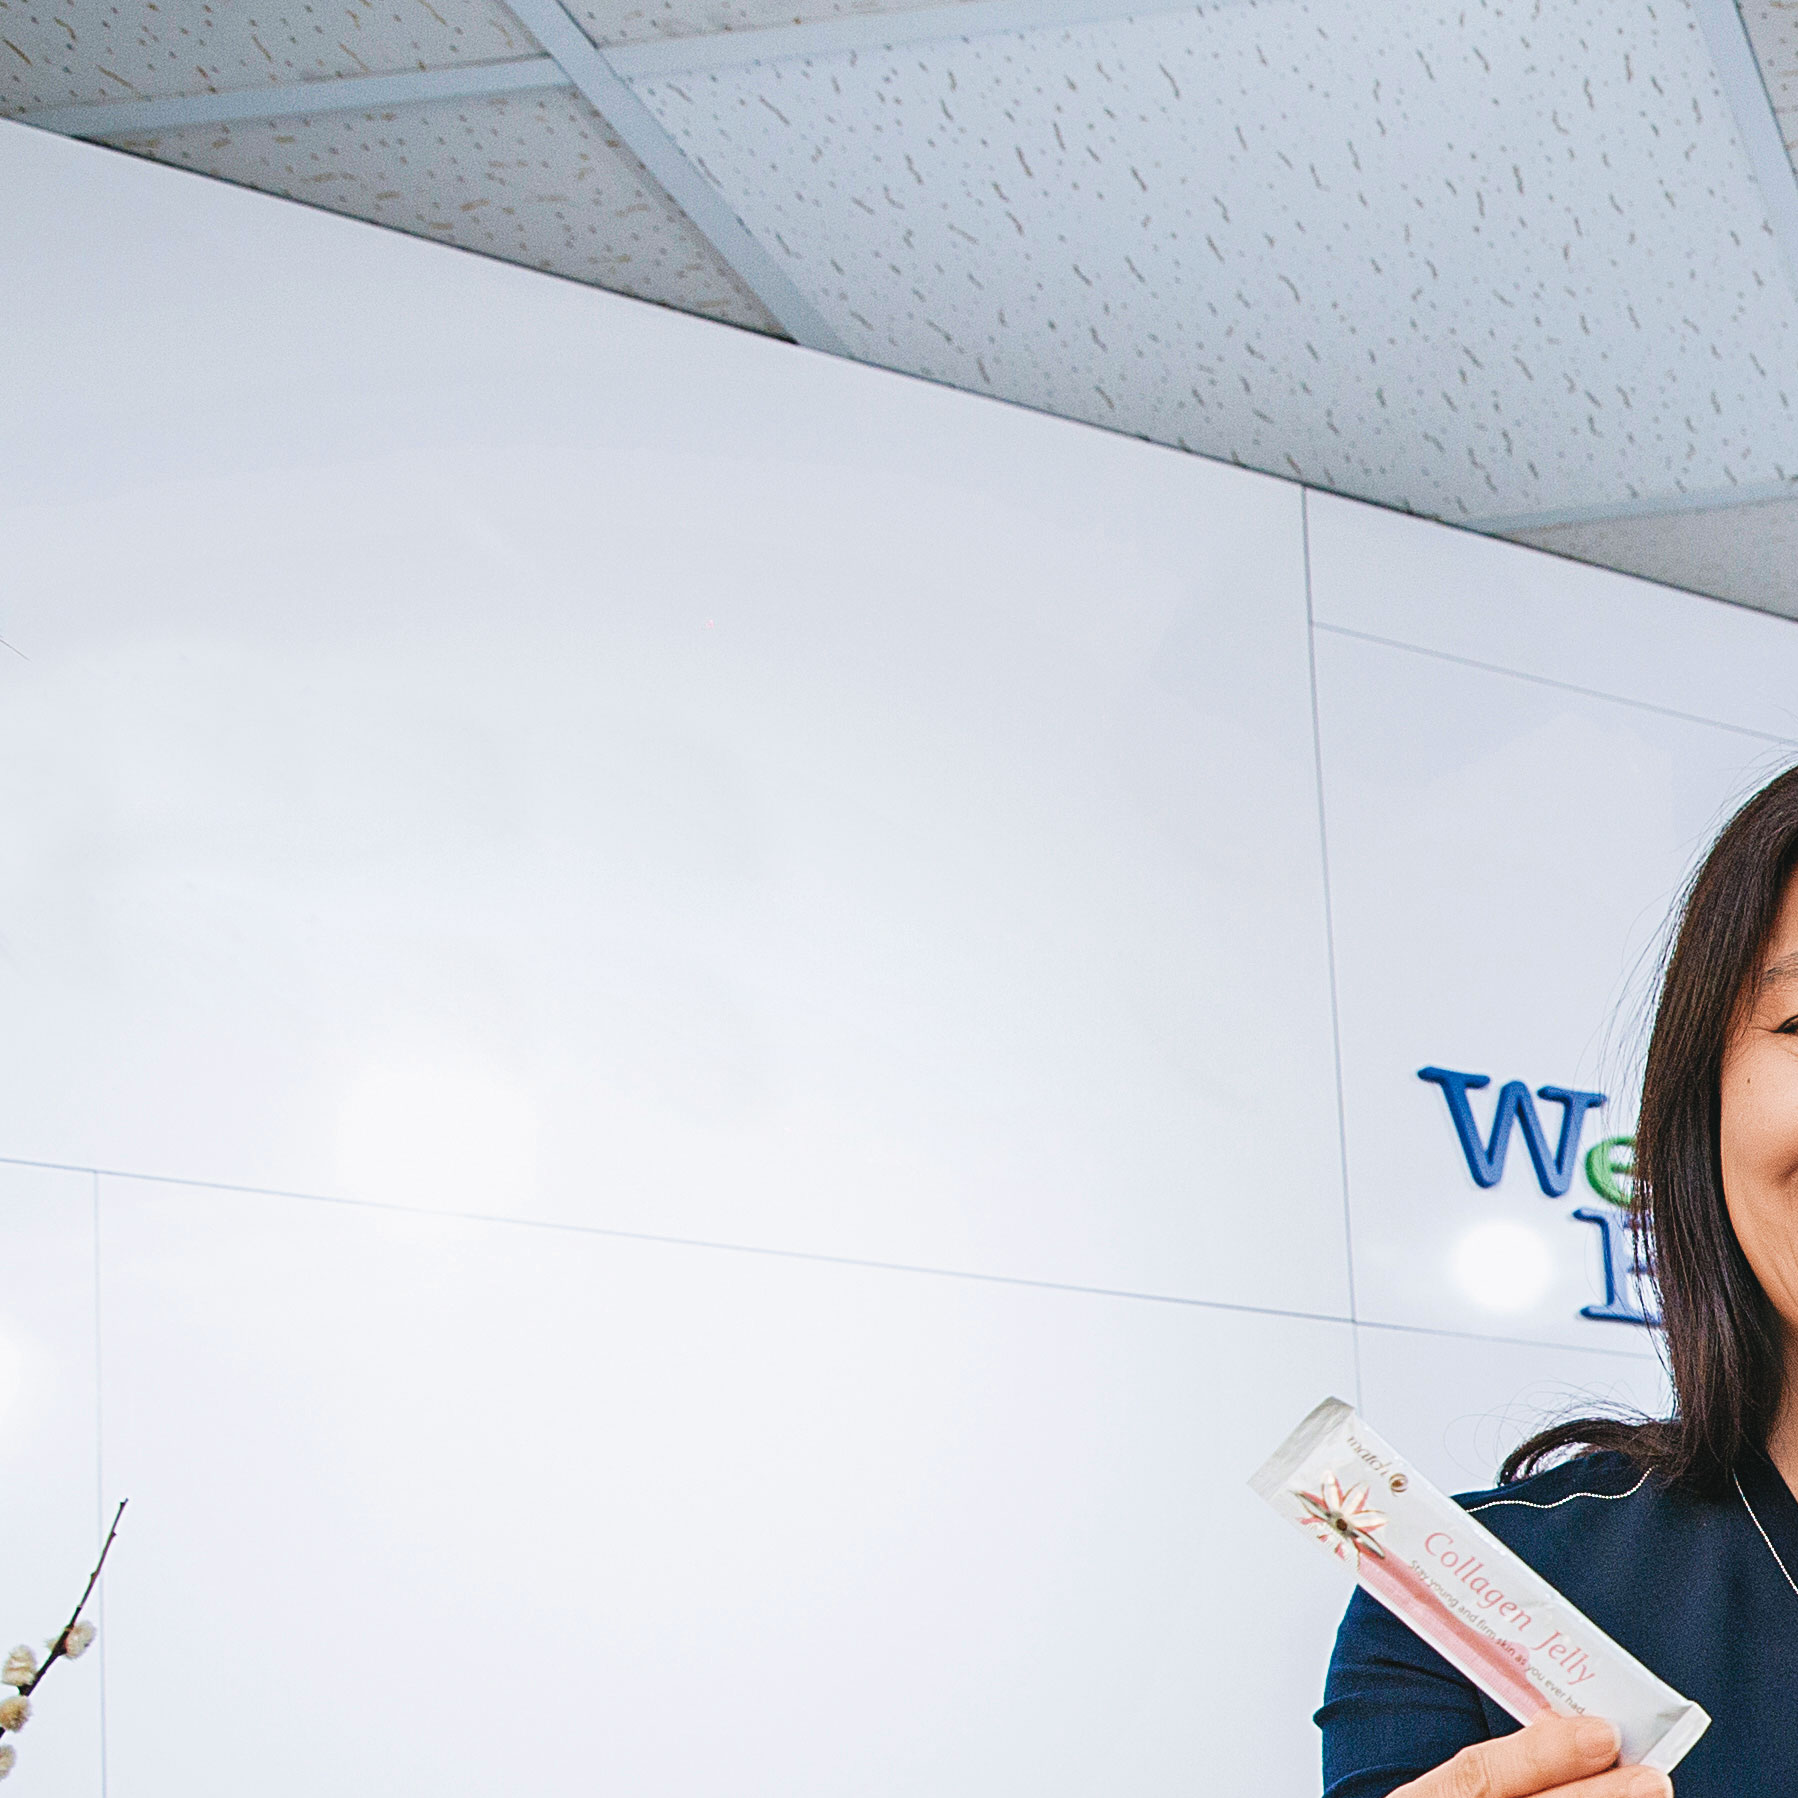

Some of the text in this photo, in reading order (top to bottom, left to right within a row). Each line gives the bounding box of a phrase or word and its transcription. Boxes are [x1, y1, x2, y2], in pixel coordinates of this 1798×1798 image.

[1346, 1435, 1390, 1481] match
[1410, 1560, 1586, 1714] Stay young and firm skin as you ever had
[1423, 1531, 1596, 1686] Collagen Jelly
